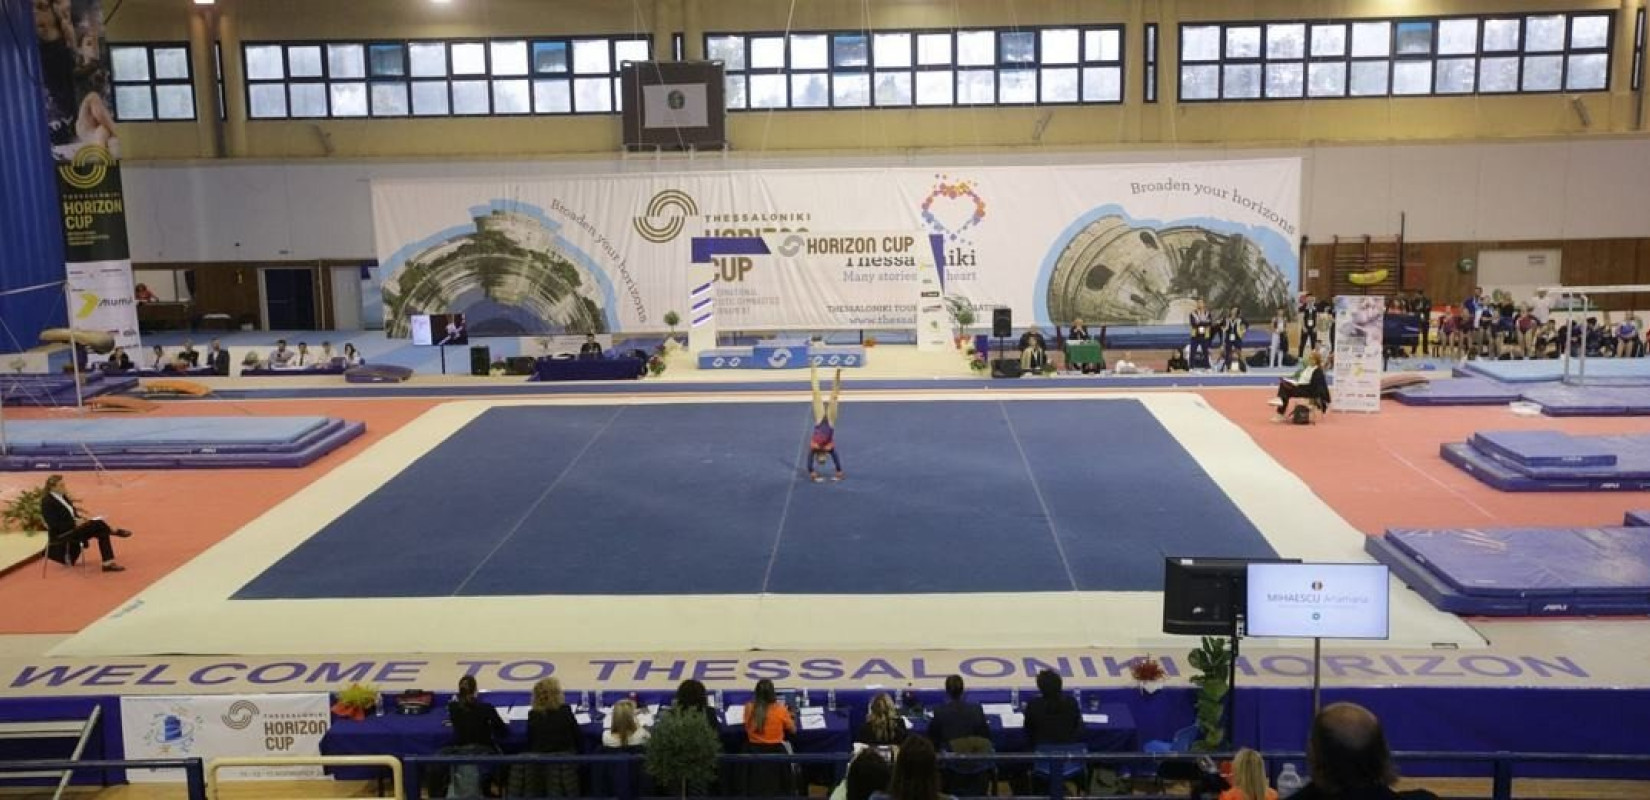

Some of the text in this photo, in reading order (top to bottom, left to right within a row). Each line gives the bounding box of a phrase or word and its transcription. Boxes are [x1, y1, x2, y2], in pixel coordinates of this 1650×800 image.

[63, 200, 122, 215] HORIZON
[1130, 177, 1296, 236] Broaden your horizons
[66, 215, 94, 230] CUP
[704, 212, 812, 223] THESSALONIKI
[807, 236, 915, 254] HORIZON CUP
[551, 198, 647, 323] Broaden your horizons
[843, 271, 877, 283] Many
[10, 661, 428, 688] WELCOME
[456, 660, 557, 683] TO
[264, 719, 328, 736] HORIZON
[265, 736, 295, 751] CUP
